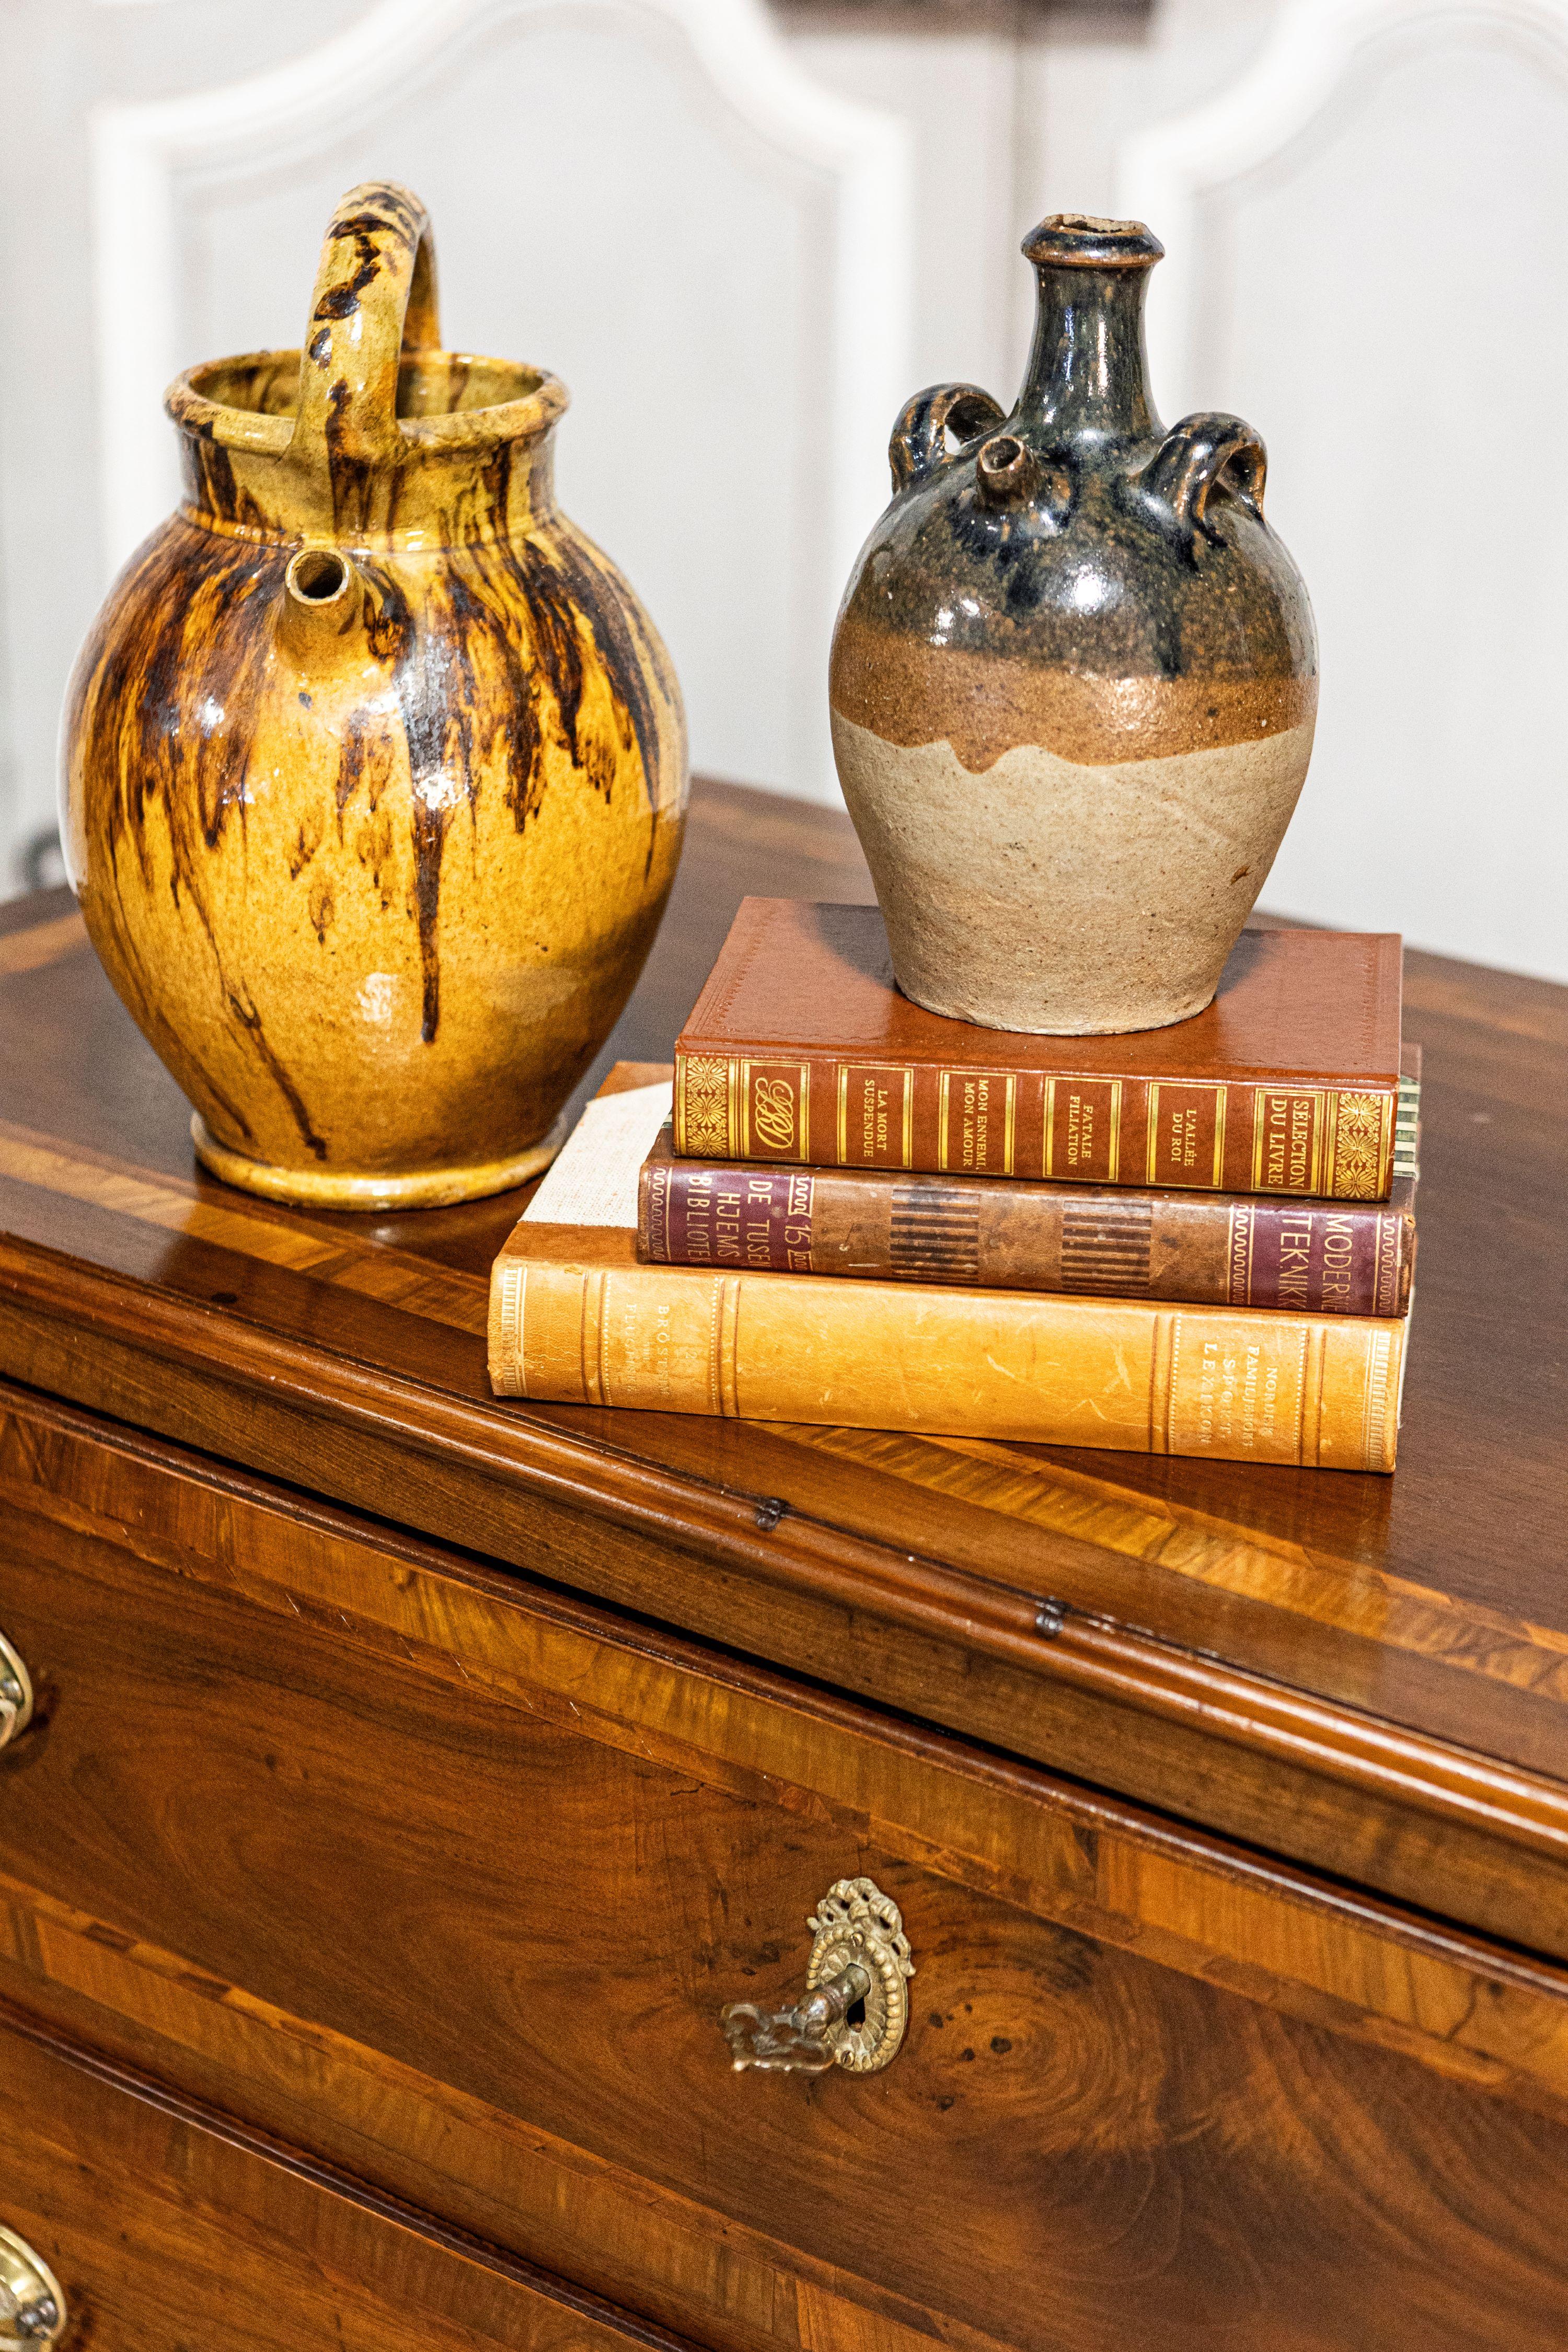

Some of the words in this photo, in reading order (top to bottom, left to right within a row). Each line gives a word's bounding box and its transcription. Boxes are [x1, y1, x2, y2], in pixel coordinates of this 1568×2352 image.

[864, 1079, 875, 1157] SUSPENDUE
[878, 1090, 888, 1109] LA
[964, 1082, 975, 1114] MON
[978, 1080, 989, 1111] MON
[1271, 1098, 1287, 1126] DU
[877, 1112, 887, 1150] MORT
[963, 1118, 973, 1166] AMOUR
[975, 1115, 987, 1170] ENNEMI,
[1068, 1096, 1080, 1165] FILIATION
[1081, 1105, 1093, 1158] FATALE
[1171, 1138, 1182, 1161] ROI
[1172, 1113, 1183, 1134] DU
[1184, 1109, 1197, 1166] L'ALLÉE
[1289, 1100, 1311, 1187] SÉLECTION
[1268, 1132, 1285, 1184] LIVRE
[747, 1179, 773, 1205] DE
[717, 1193, 740, 1257] HJEMS
[785, 1225, 811, 1244] 15
[1278, 1214, 1312, 1309] TEKNIKK
[1321, 1214, 1354, 1311] MODERNE
[1200, 1343, 1217, 1444] LEXIKON
